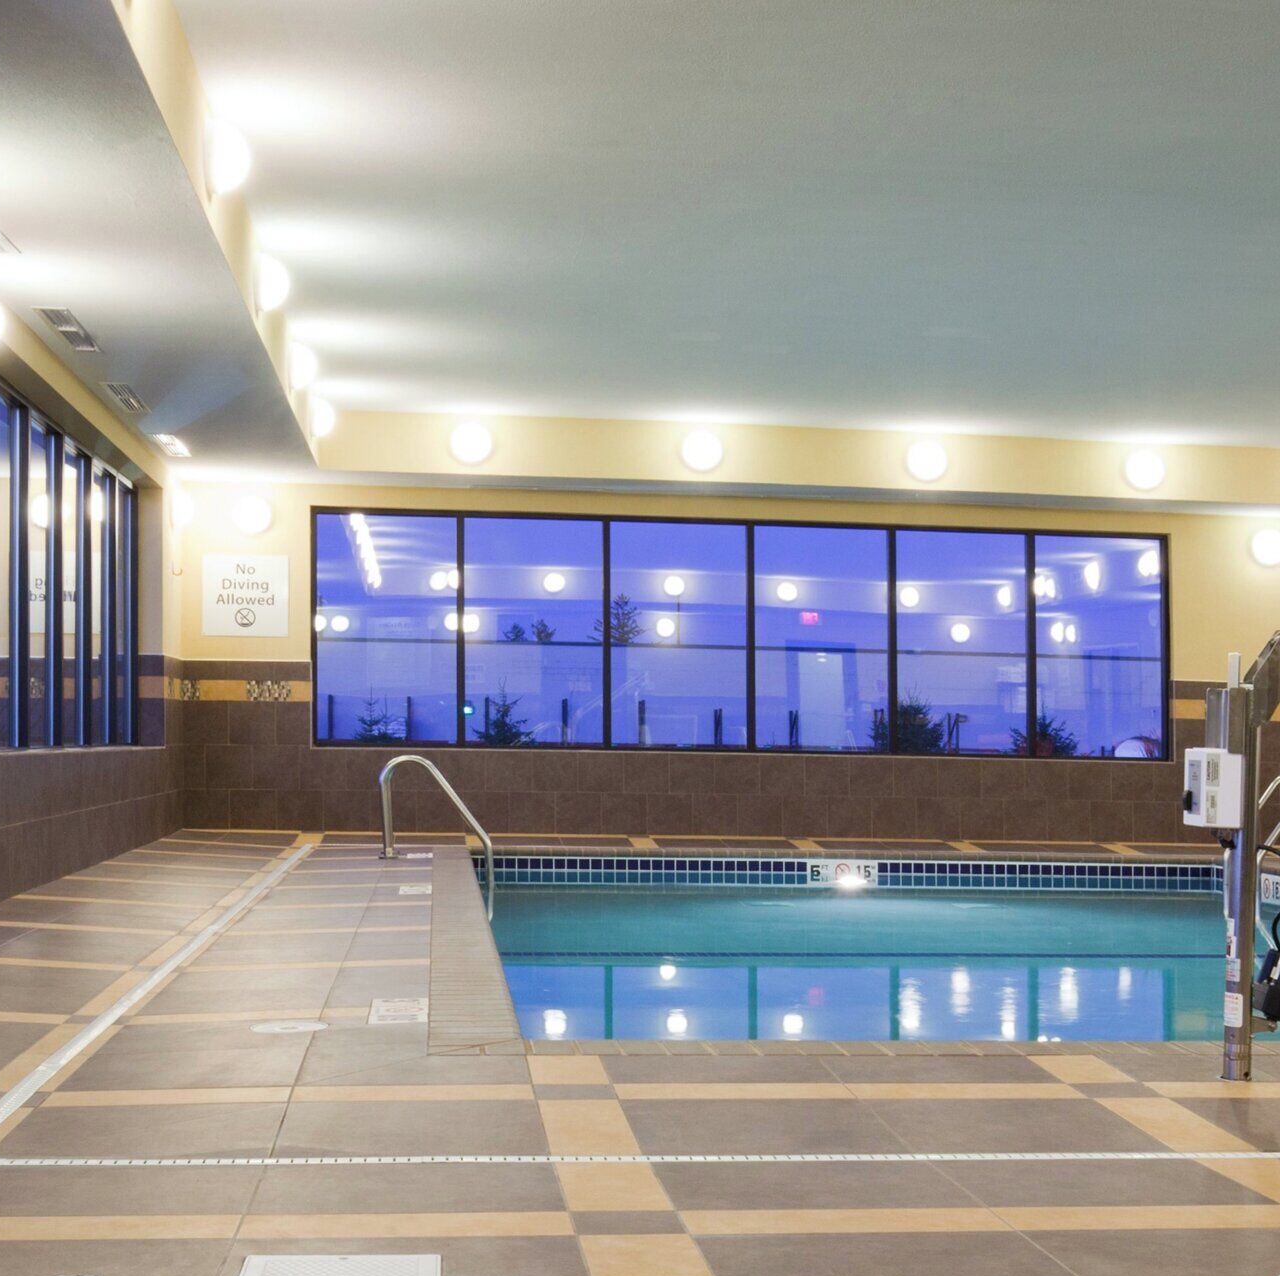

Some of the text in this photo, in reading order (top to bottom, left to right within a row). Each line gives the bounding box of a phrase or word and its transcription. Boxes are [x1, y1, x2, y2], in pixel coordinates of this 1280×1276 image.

[236, 564, 256, 575] No
[222, 579, 269, 593] Diving
[216, 594, 275, 606] Allowed
